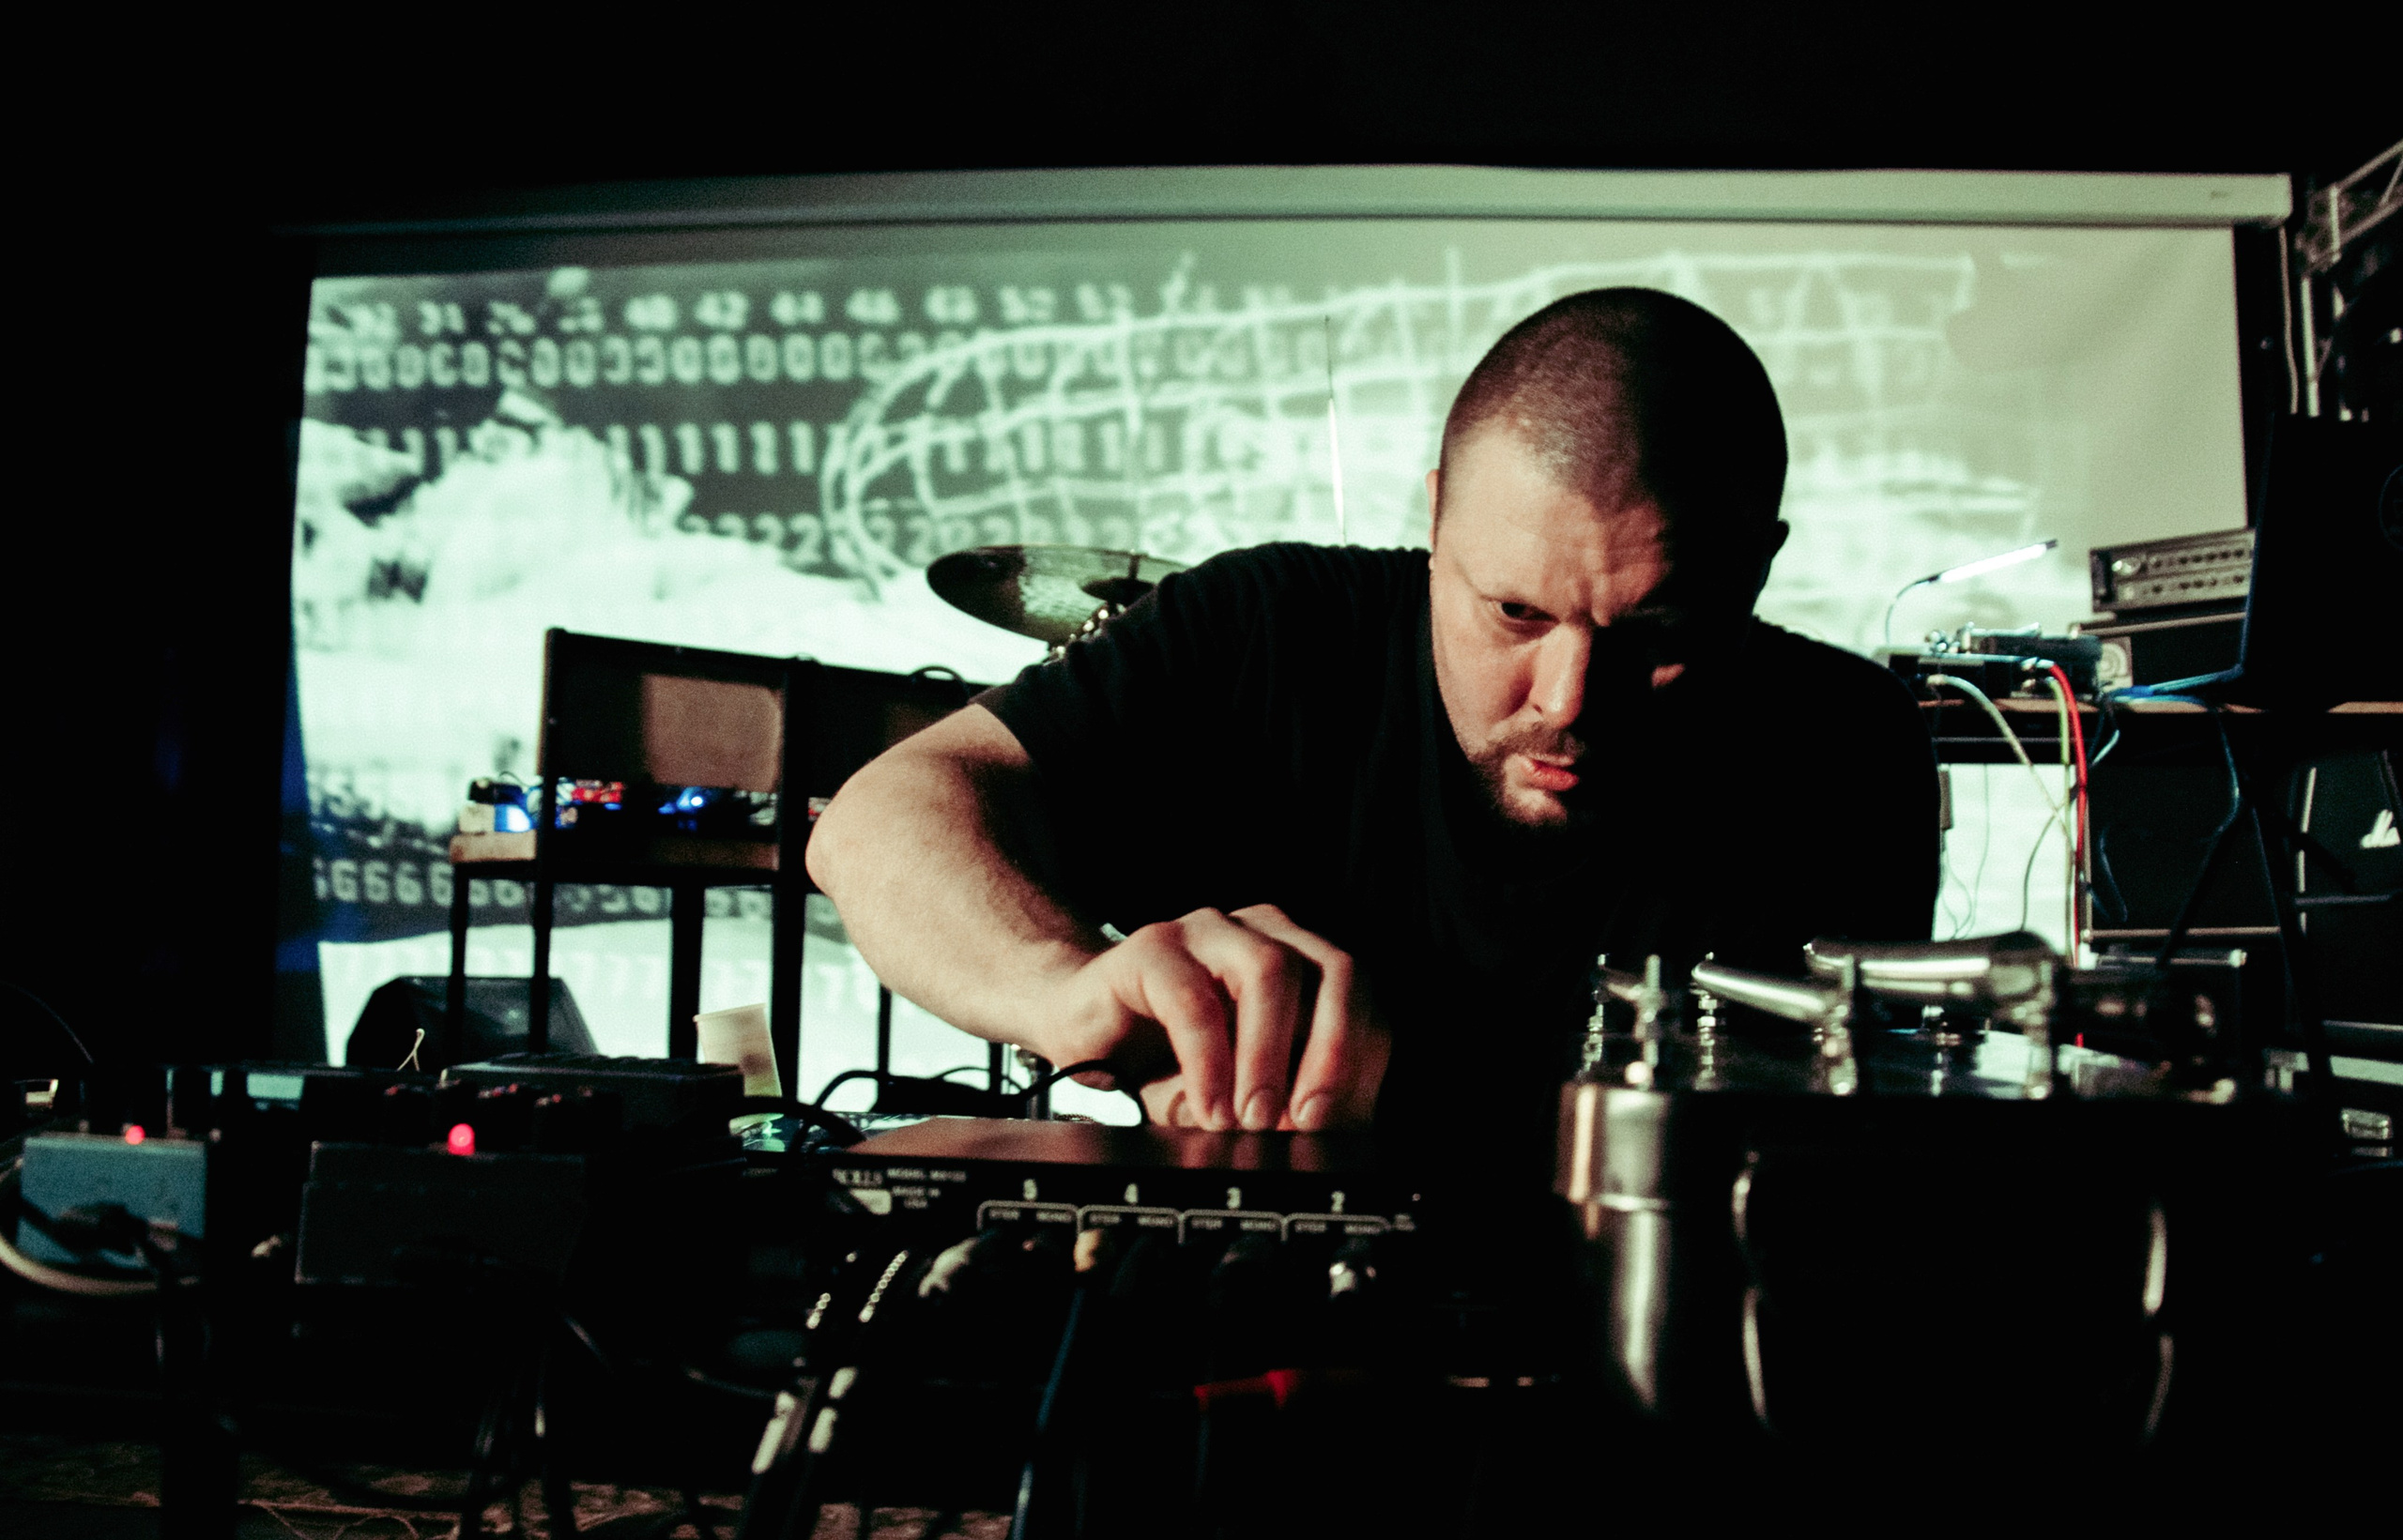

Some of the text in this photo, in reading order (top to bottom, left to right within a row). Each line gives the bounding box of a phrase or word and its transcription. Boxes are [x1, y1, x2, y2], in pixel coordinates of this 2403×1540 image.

[1124, 1182, 1139, 1204] 4
[1226, 1186, 1241, 1209] 3
[1330, 1190, 1345, 1212] 2
